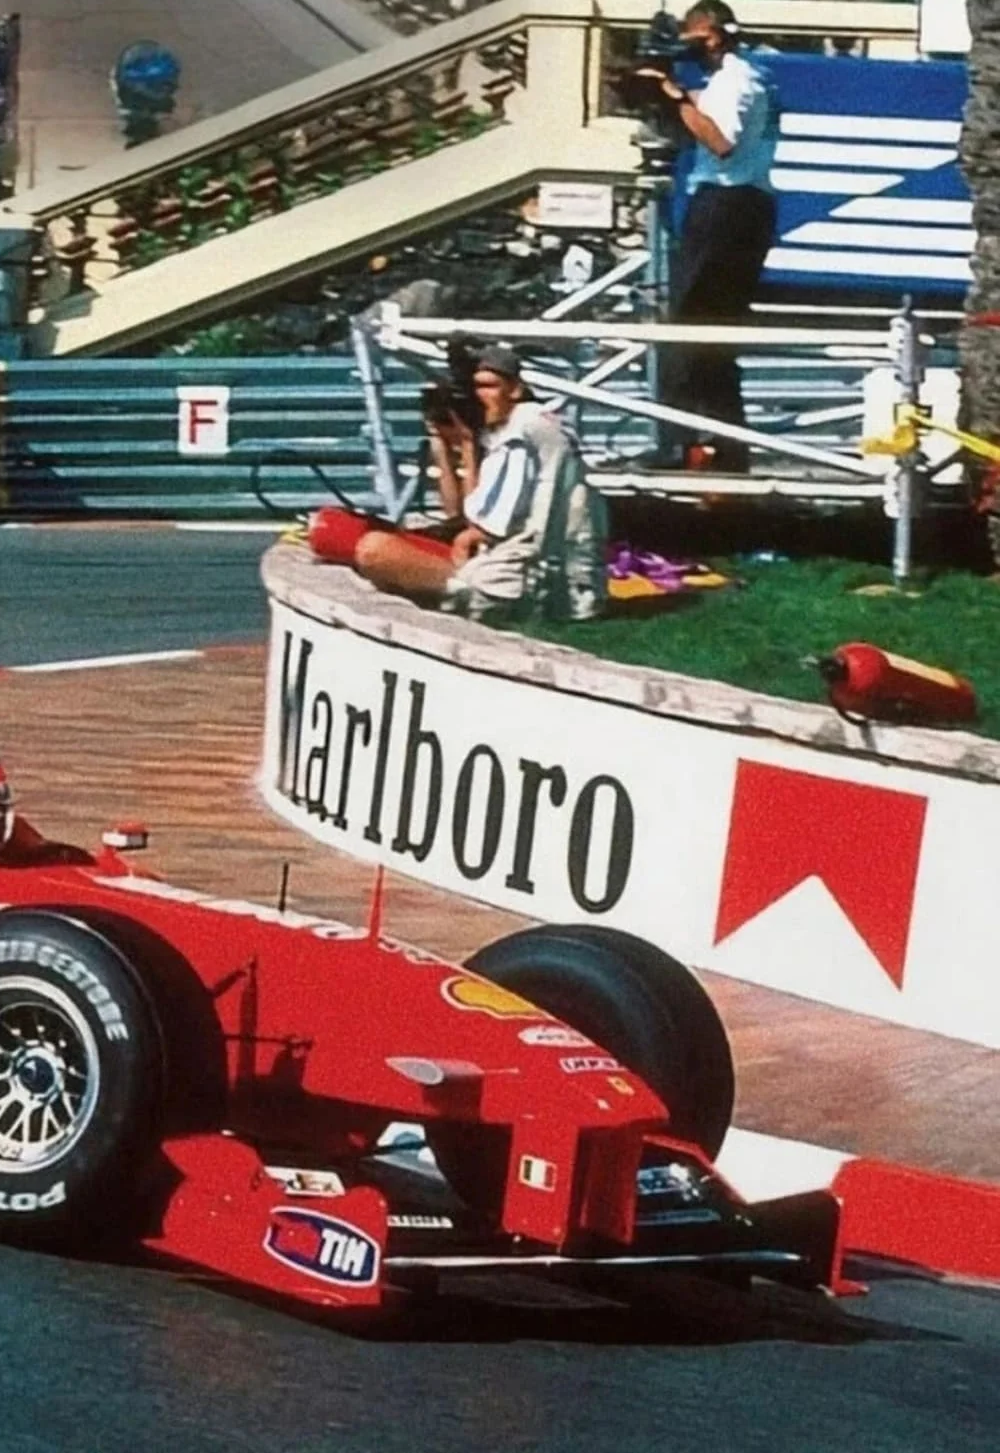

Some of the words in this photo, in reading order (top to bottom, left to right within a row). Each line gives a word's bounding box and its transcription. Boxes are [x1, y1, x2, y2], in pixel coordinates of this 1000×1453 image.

[189, 400, 218, 444] F
[278, 631, 634, 914] Marlboro
[319, 1228, 369, 1277] TIM
